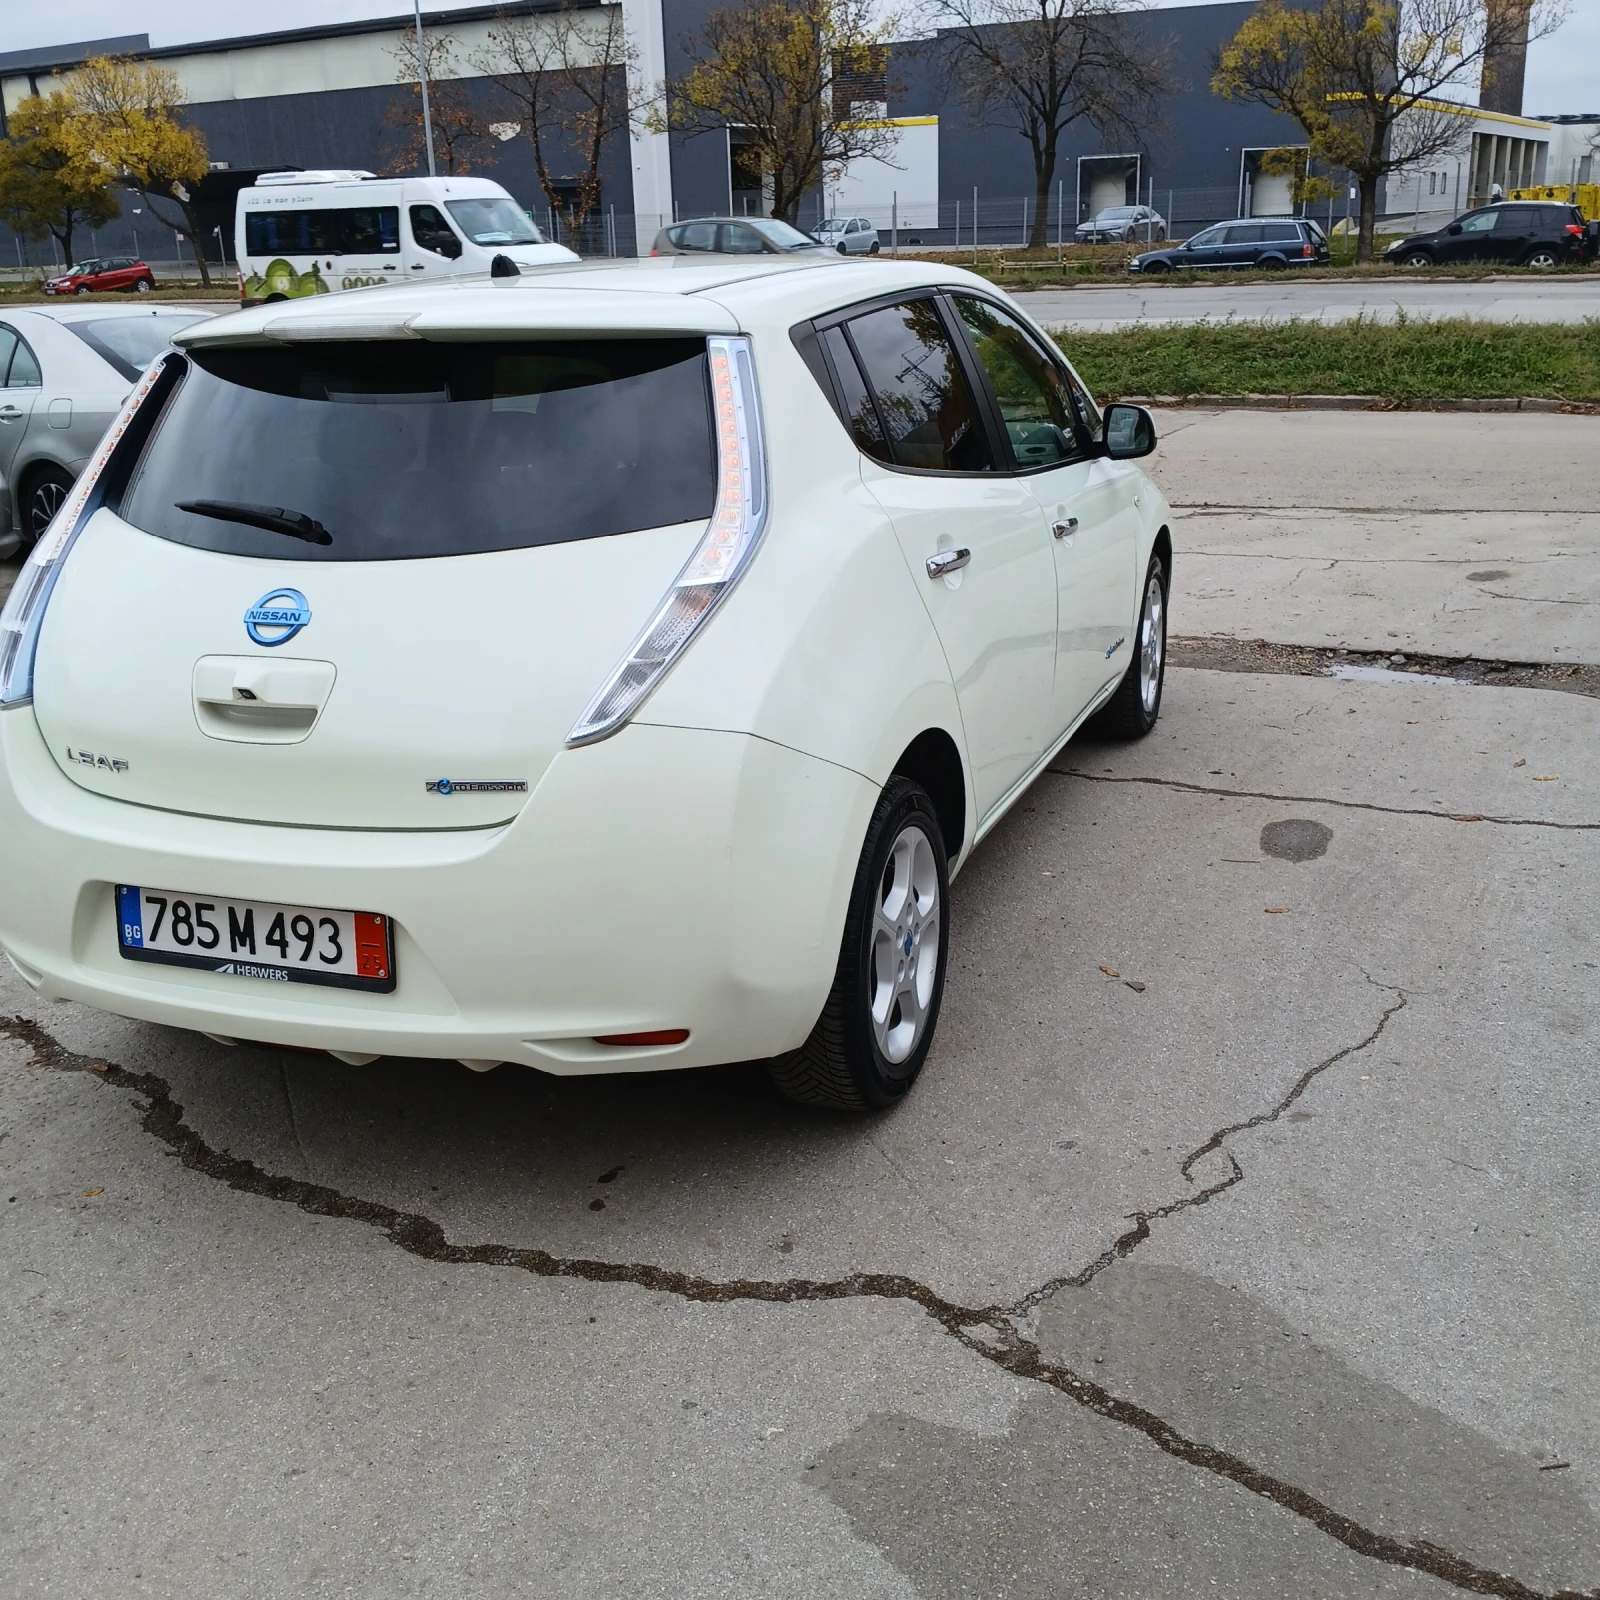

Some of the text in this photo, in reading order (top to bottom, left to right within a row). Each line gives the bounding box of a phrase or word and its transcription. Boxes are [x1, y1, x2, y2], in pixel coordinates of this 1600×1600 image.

[248, 611, 302, 622] NISSAN
[65, 746, 129, 773] LEAF
[124, 923, 141, 939] BG
[145, 896, 343, 965] 785 M 493
[236, 964, 289, 982] HERWERS
